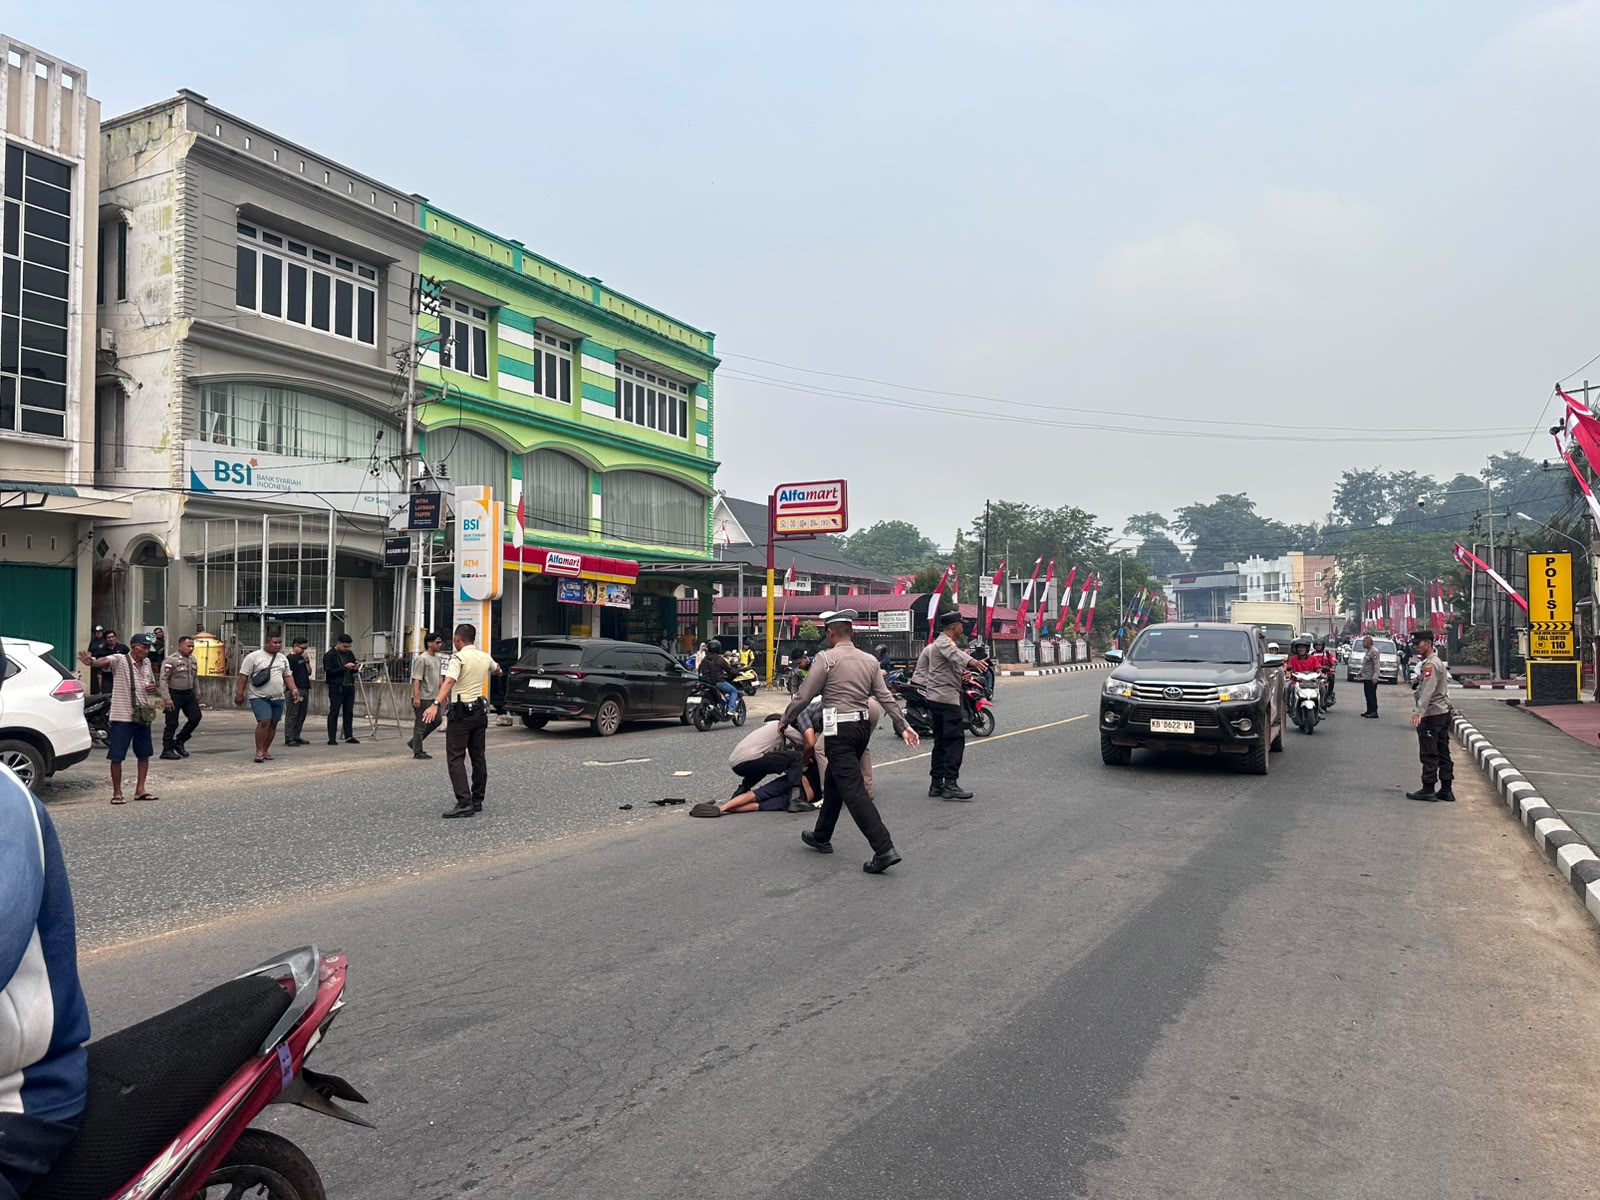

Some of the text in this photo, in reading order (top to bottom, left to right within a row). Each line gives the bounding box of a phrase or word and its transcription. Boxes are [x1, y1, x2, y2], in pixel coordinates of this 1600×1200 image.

[214, 459, 252, 486] BSI
[256, 473, 302, 486] BANK SYARIAH
[256, 481, 292, 491] INDONESIA
[779, 487, 839, 502] Alfamart
[463, 519, 479, 531] BSI
[548, 553, 580, 567] Alfamart
[1545, 557, 1557, 620] POLISI
[1551, 641, 1566, 650] 110
[1151, 720, 1161, 728] KB
[1163, 721, 1181, 729] 8622
